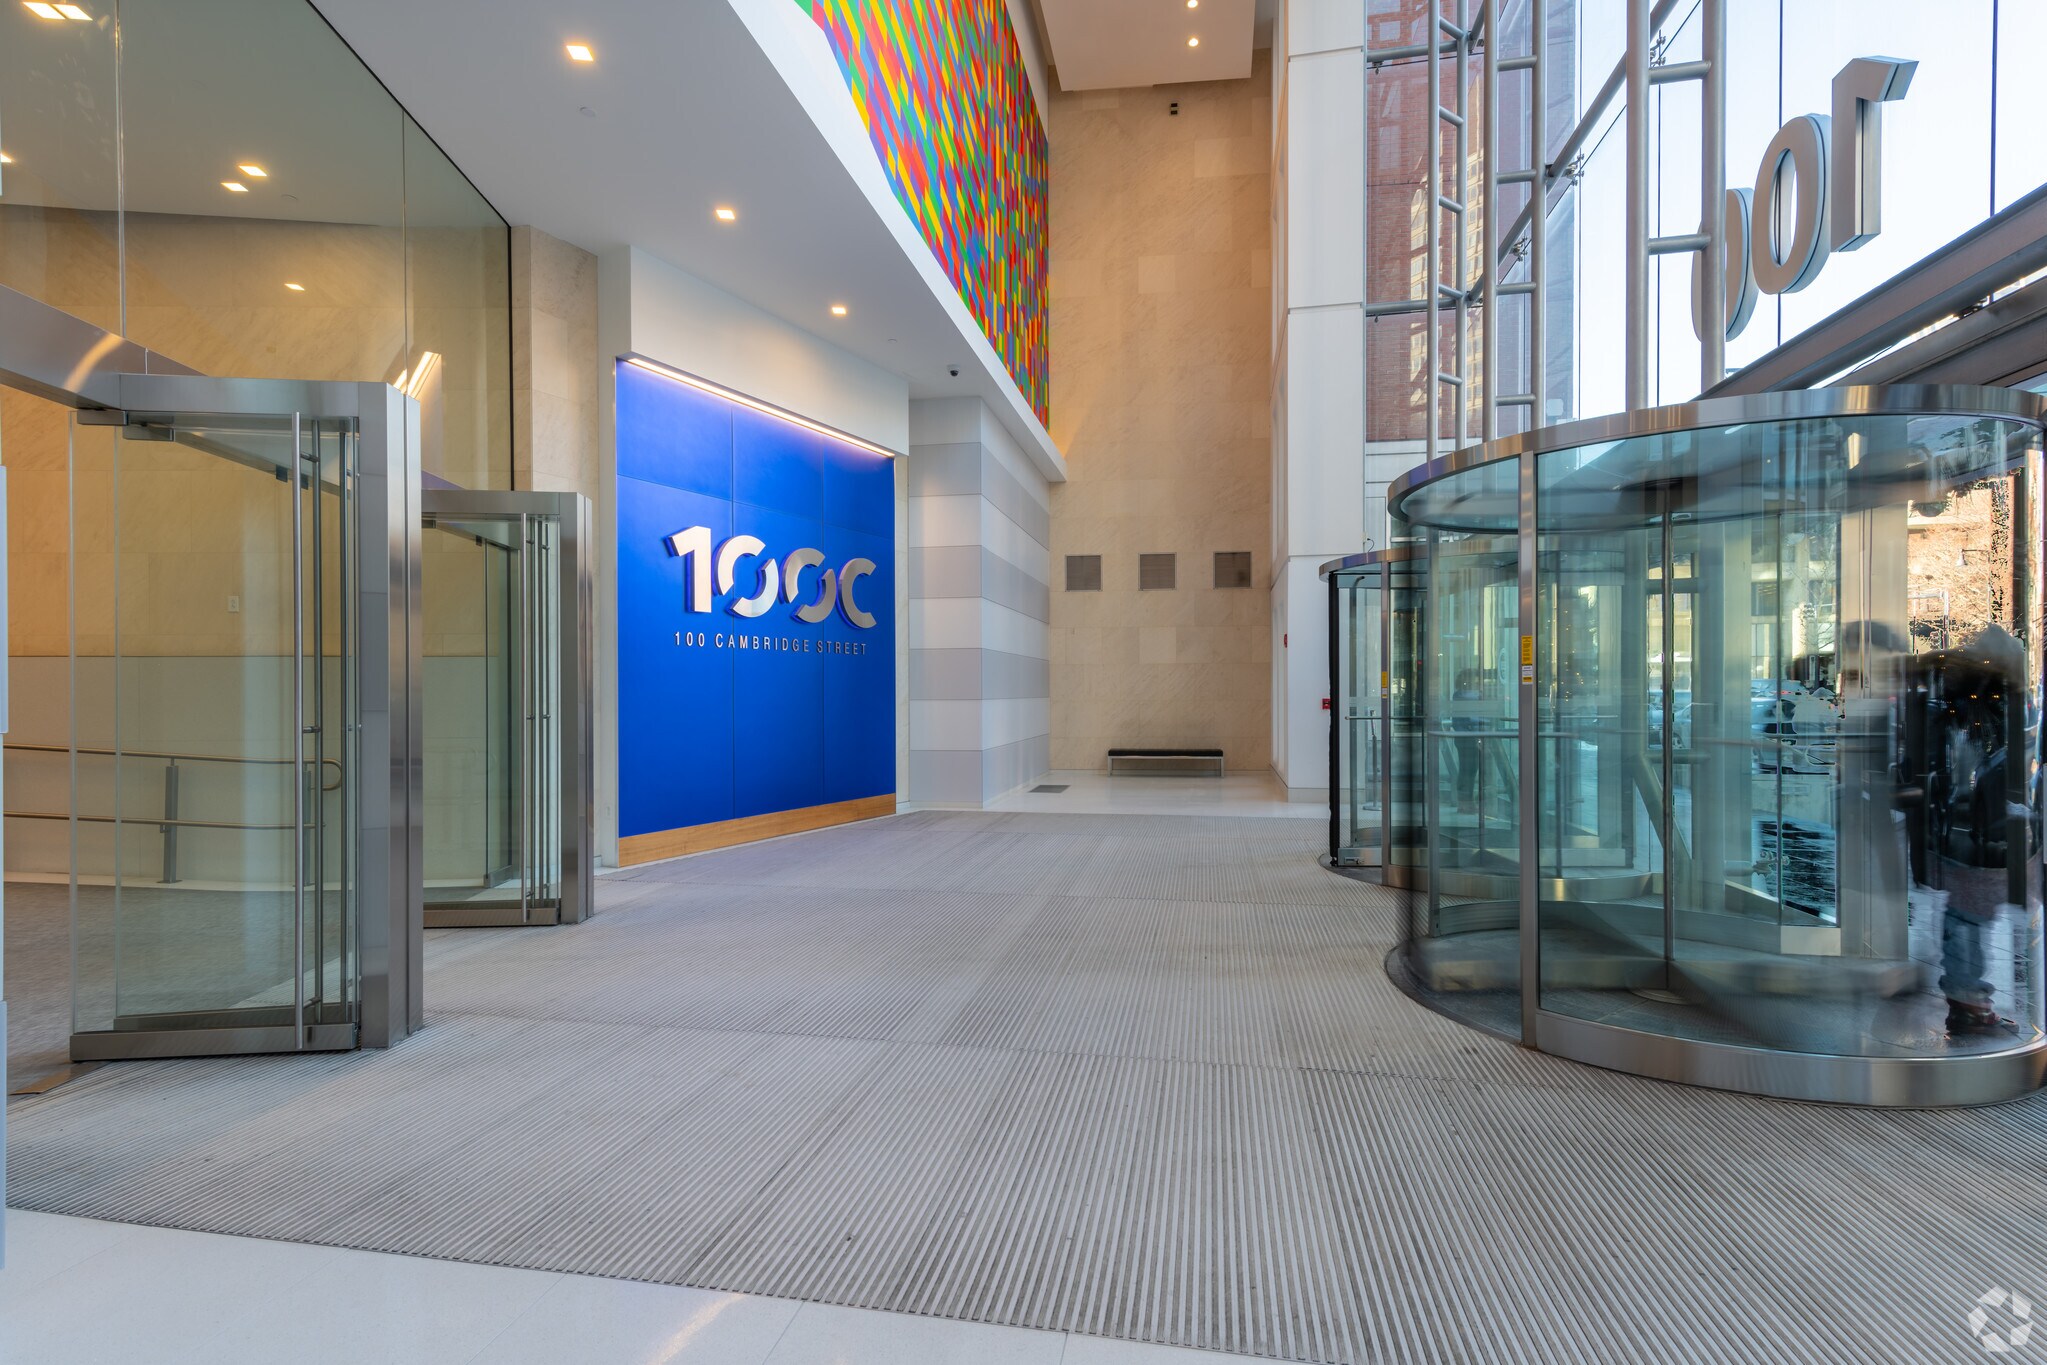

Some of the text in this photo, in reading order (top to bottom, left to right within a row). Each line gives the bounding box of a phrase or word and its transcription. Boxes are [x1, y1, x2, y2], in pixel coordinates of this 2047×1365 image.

[674, 631, 866, 655] 100 CAMBRIDGE STREET
